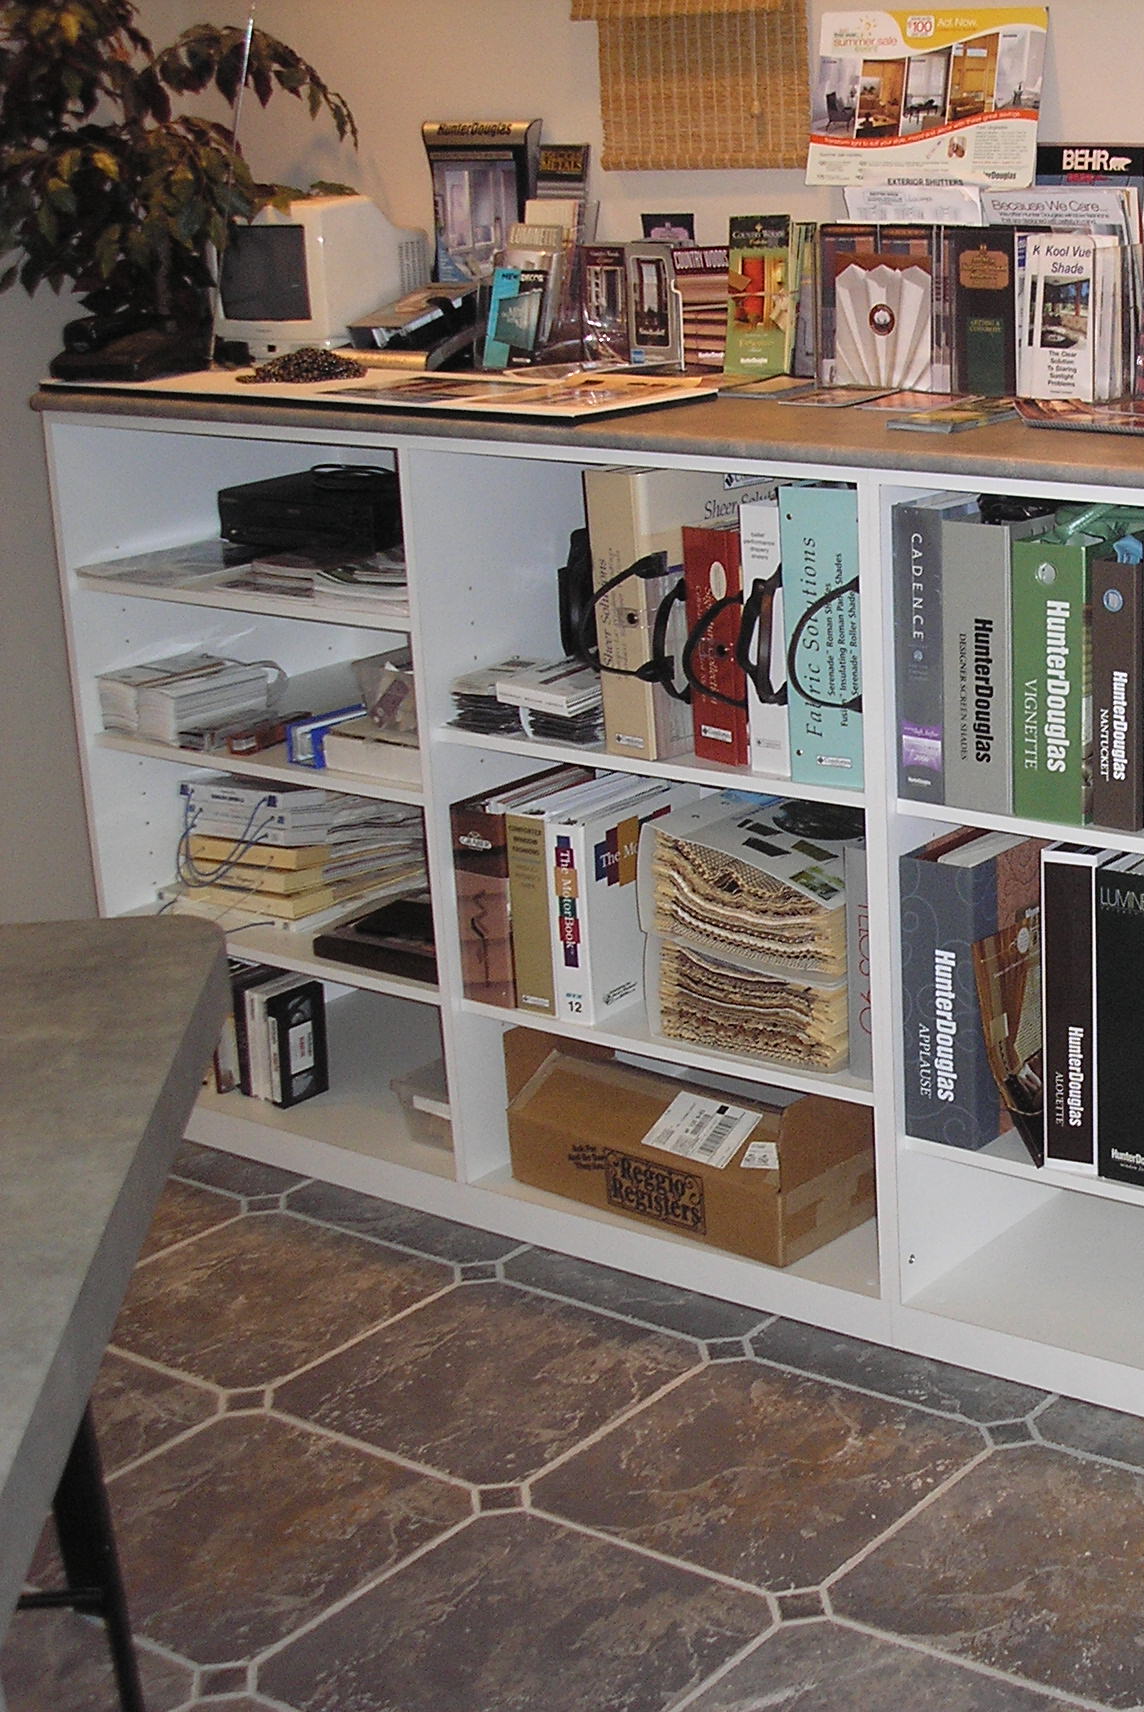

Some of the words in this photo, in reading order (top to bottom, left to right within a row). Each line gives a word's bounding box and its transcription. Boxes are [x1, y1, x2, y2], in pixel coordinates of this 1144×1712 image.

[937, 18, 954, 27] Act
[957, 18, 976, 26] Now
[833, 37, 875, 48] summer
[877, 38, 898, 46] sale
[437, 122, 513, 137] HunterDouglas
[1062, 149, 1109, 171] BEHR
[888, 178, 923, 186] EXTERIOR
[924, 178, 964, 186] SHUTTERS
[992, 200, 1045, 211] Because
[1045, 200, 1068, 211] We
[1045, 246, 1069, 257] Kool
[1072, 246, 1092, 258] Vue
[1051, 262, 1084, 274] Shade
[1050, 373, 1074, 381] Sunlight
[704, 499, 737, 520] Sheer
[835, 554, 843, 584] Shades
[911, 533, 924, 640] CADENCE
[848, 591, 856, 618] Shade
[849, 621, 857, 647] Roller
[839, 648, 848, 691] Insulating
[974, 618, 994, 763] HunterDouglas
[1045, 600, 1070, 773] HunterDouglas
[1024, 679, 1038, 770] VIGNETTE
[1113, 671, 1128, 781] HunterDouglas
[559, 850, 569, 875] The
[599, 851, 620, 868] The
[568, 1001, 582, 1013] 12
[935, 949, 957, 1102] HunterDouglas
[919, 1023, 931, 1096] APPLAUSE
[1068, 1027, 1084, 1127] HunterDouglas
[1056, 1072, 1064, 1126] ALOUETTE
[621, 1158, 685, 1197] Reggio
[611, 1177, 701, 1225] Registers
